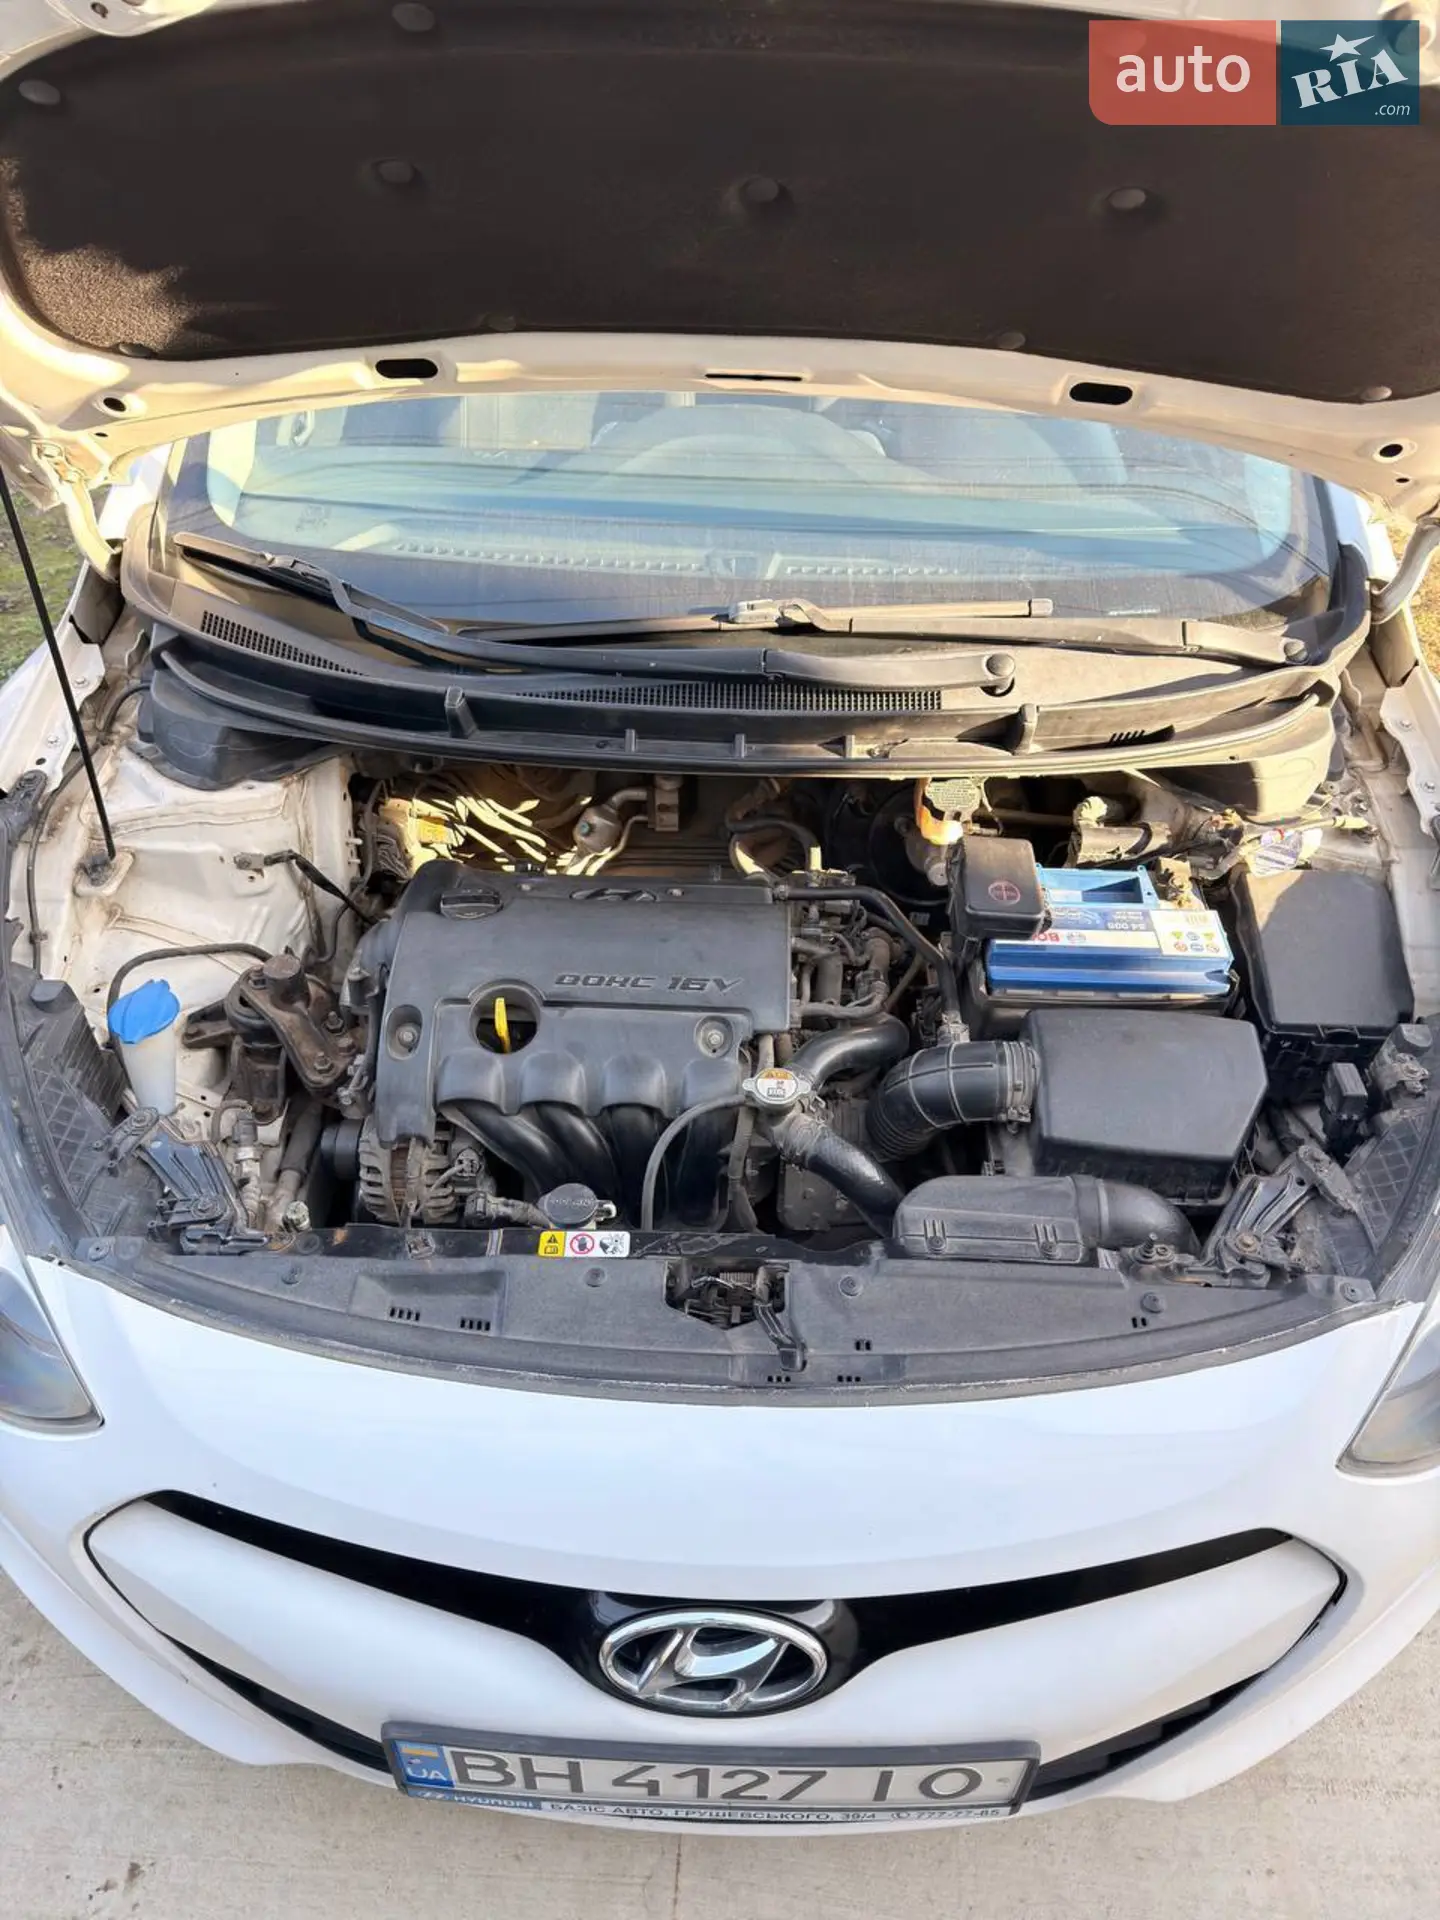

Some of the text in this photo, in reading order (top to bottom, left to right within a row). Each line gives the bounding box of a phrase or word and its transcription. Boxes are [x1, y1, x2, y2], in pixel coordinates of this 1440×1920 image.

[554, 973, 743, 995] DOHC 16V
[406, 1765, 446, 1781] UA
[450, 1750, 983, 1802] BH 4127 IO
[454, 1795, 534, 1808] HYUNDAI
